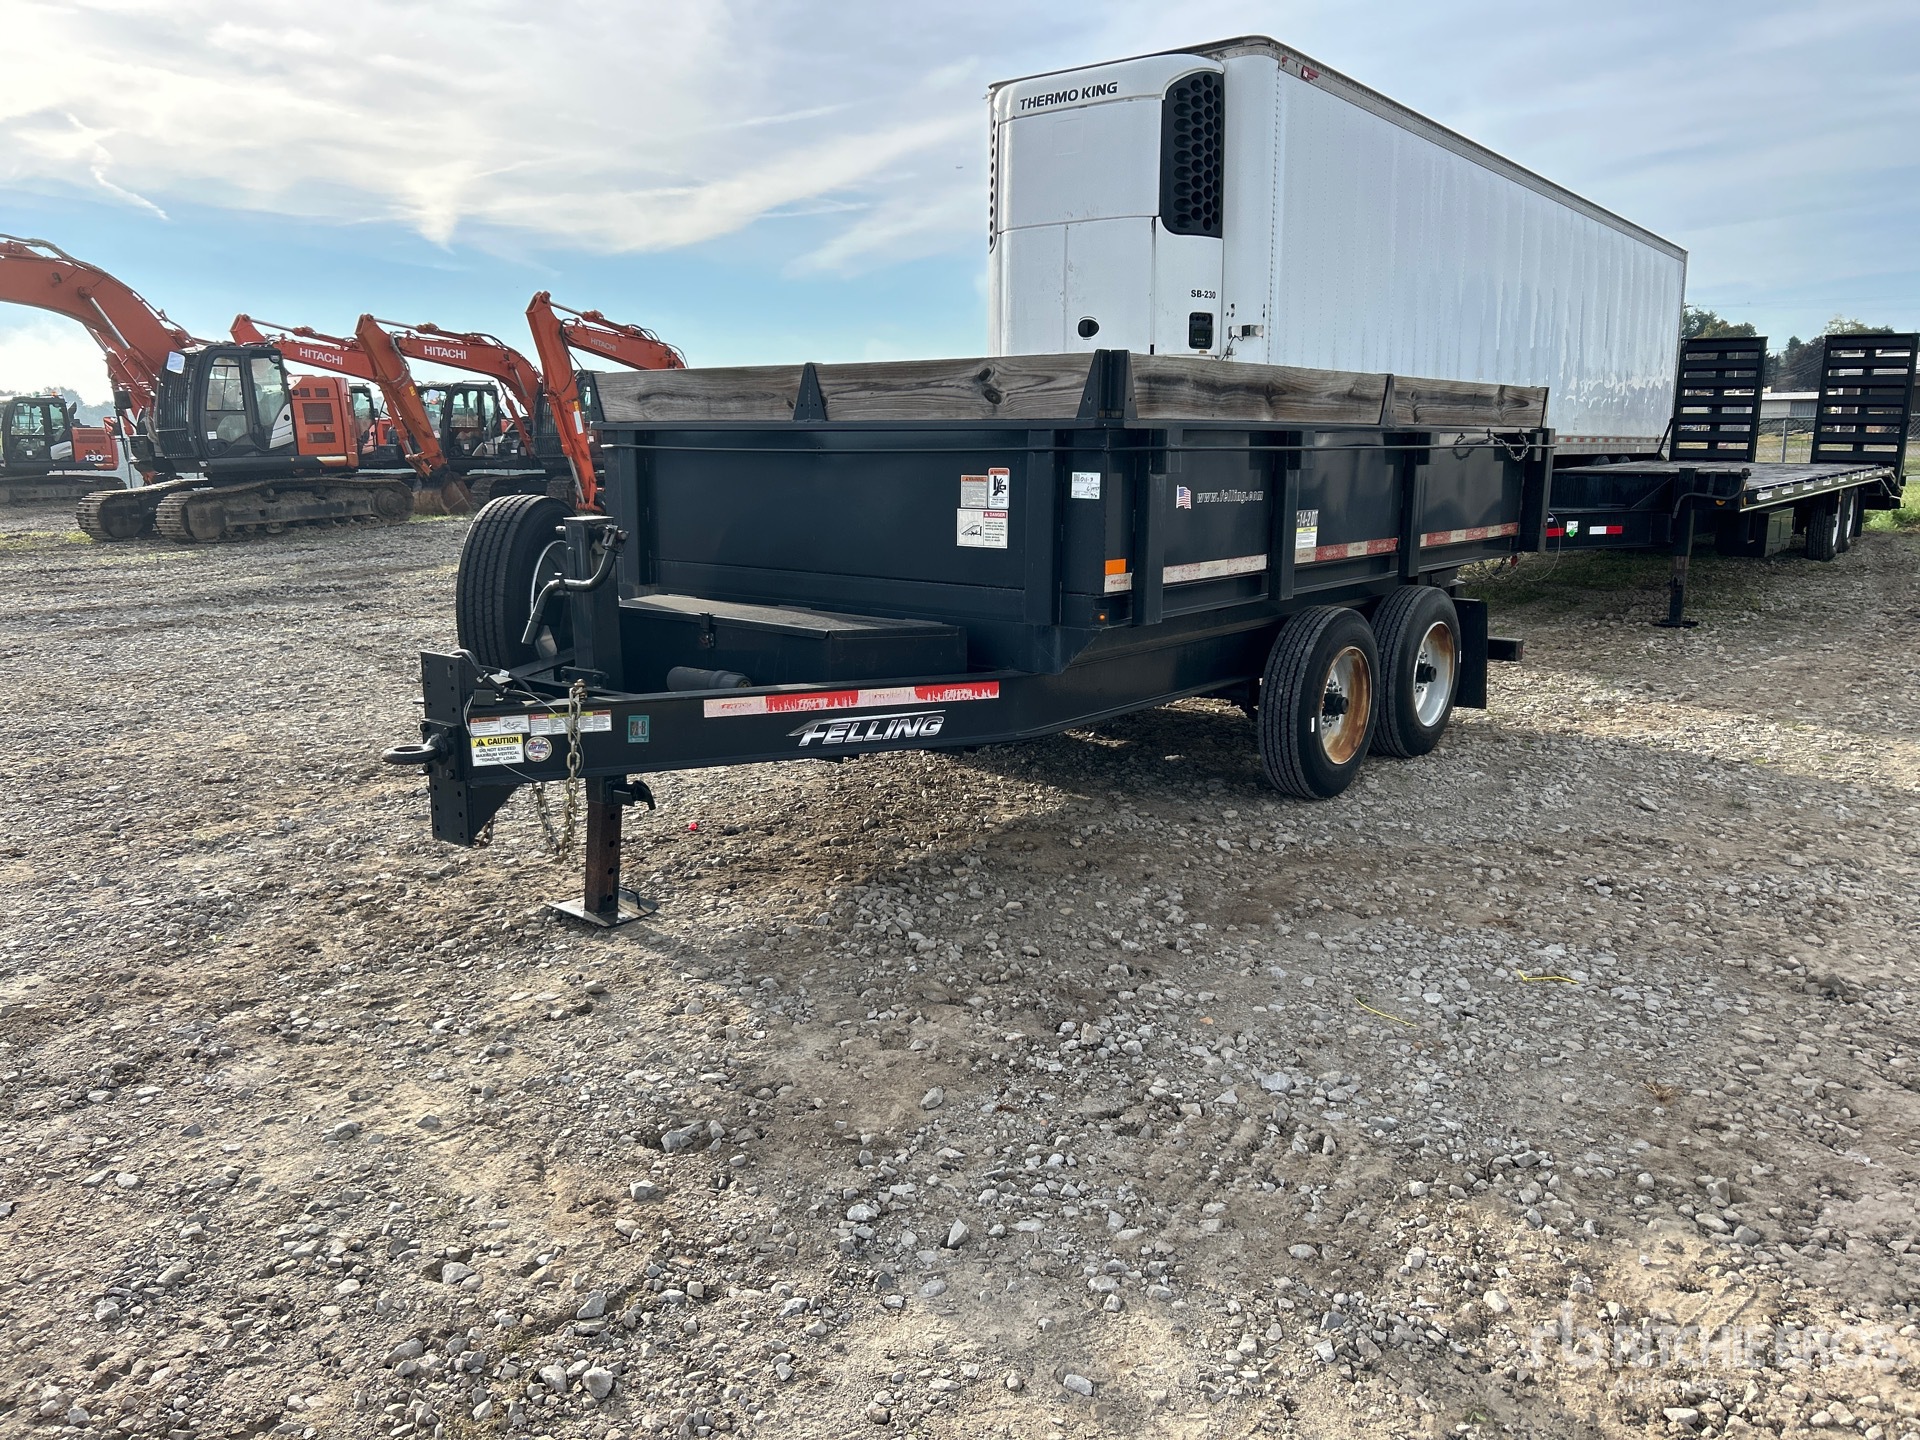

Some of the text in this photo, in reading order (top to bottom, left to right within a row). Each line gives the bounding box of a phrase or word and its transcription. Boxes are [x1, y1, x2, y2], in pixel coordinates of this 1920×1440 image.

[1020, 81, 1118, 110] THERMO KING
[591, 337, 617, 352] HITACHI
[299, 347, 343, 365] HITACHI
[424, 345, 467, 360] HITACHI
[85, 454, 104, 462] 130
[796, 713, 945, 746] FELLING
[487, 736, 519, 746] CAUTION
